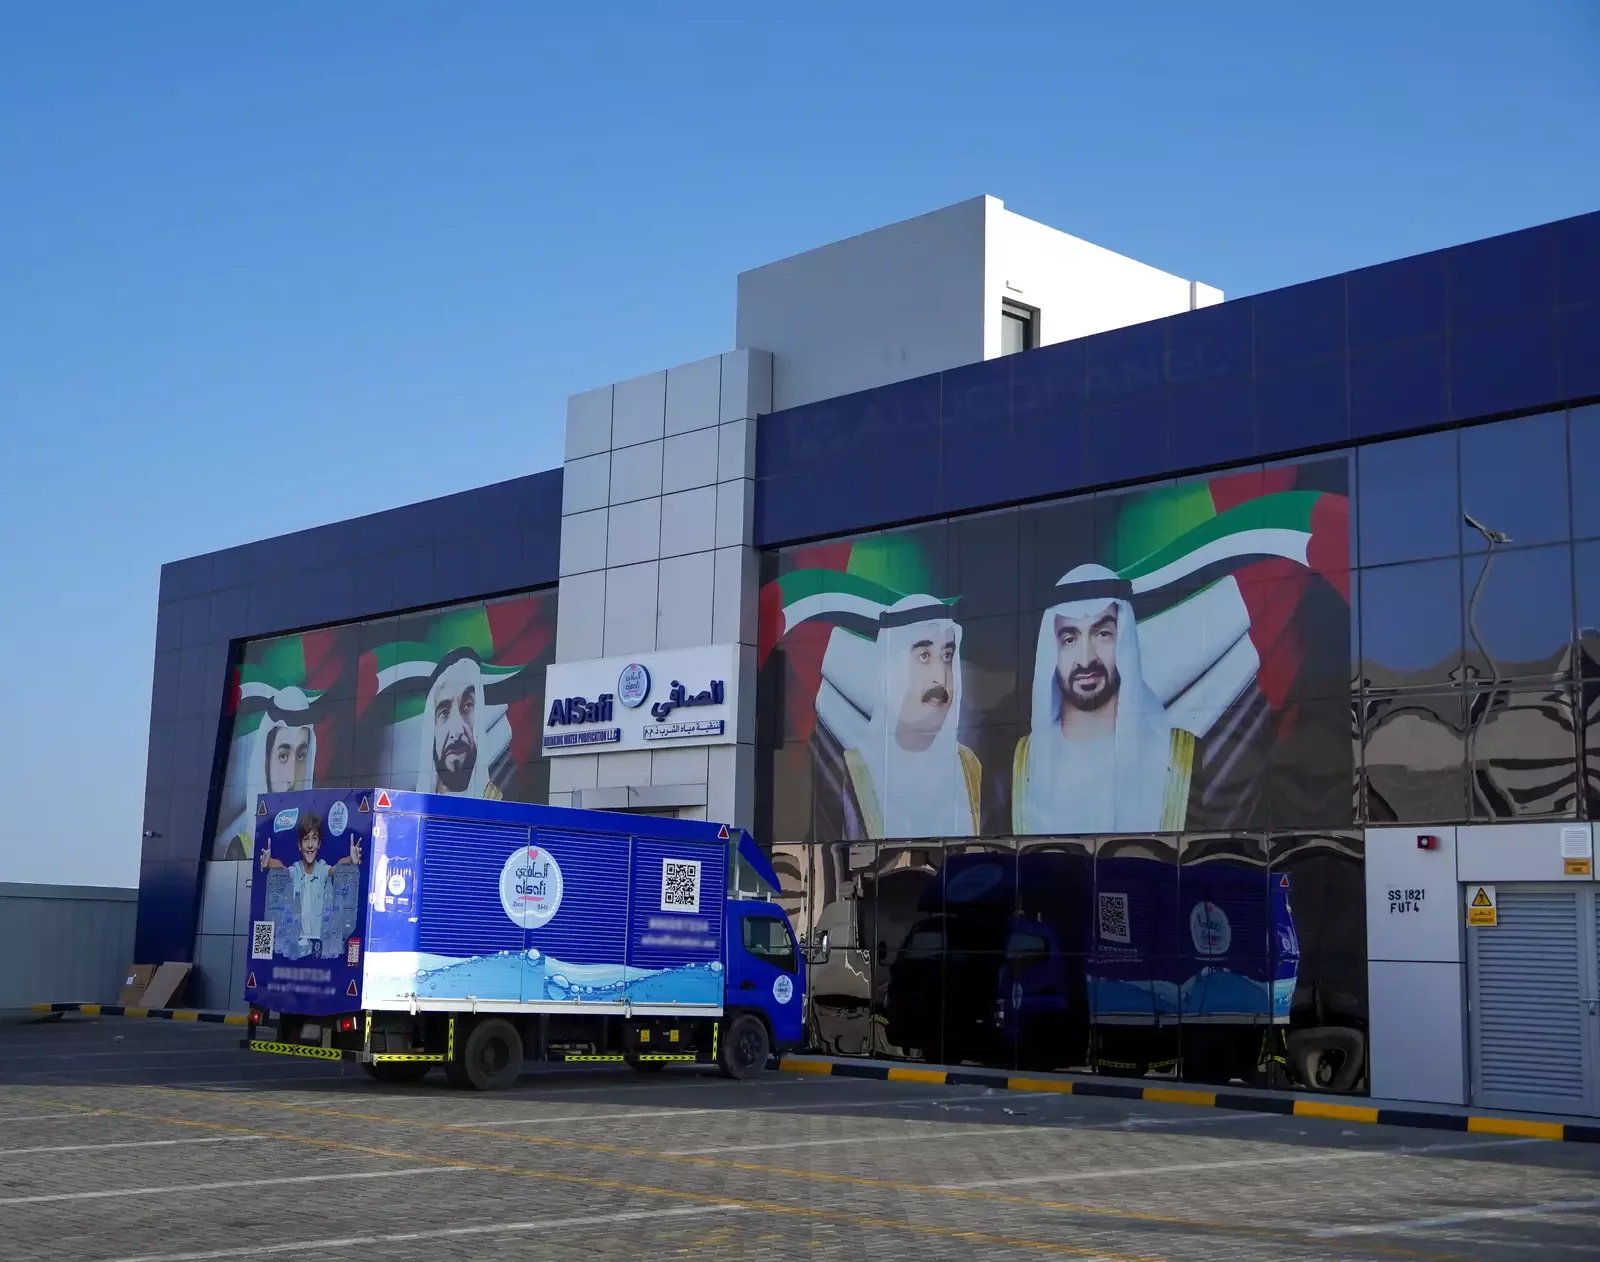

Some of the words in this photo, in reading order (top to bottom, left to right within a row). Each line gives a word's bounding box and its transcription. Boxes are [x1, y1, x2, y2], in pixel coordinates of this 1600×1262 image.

[651, 680, 724, 722] الصافي
[547, 694, 613, 726] AlSafi
[660, 724, 679, 737] الشرب
[515, 879, 546, 896] alsafi
[1388, 890, 1401, 900] SS
[1404, 889, 1425, 900] 1821
